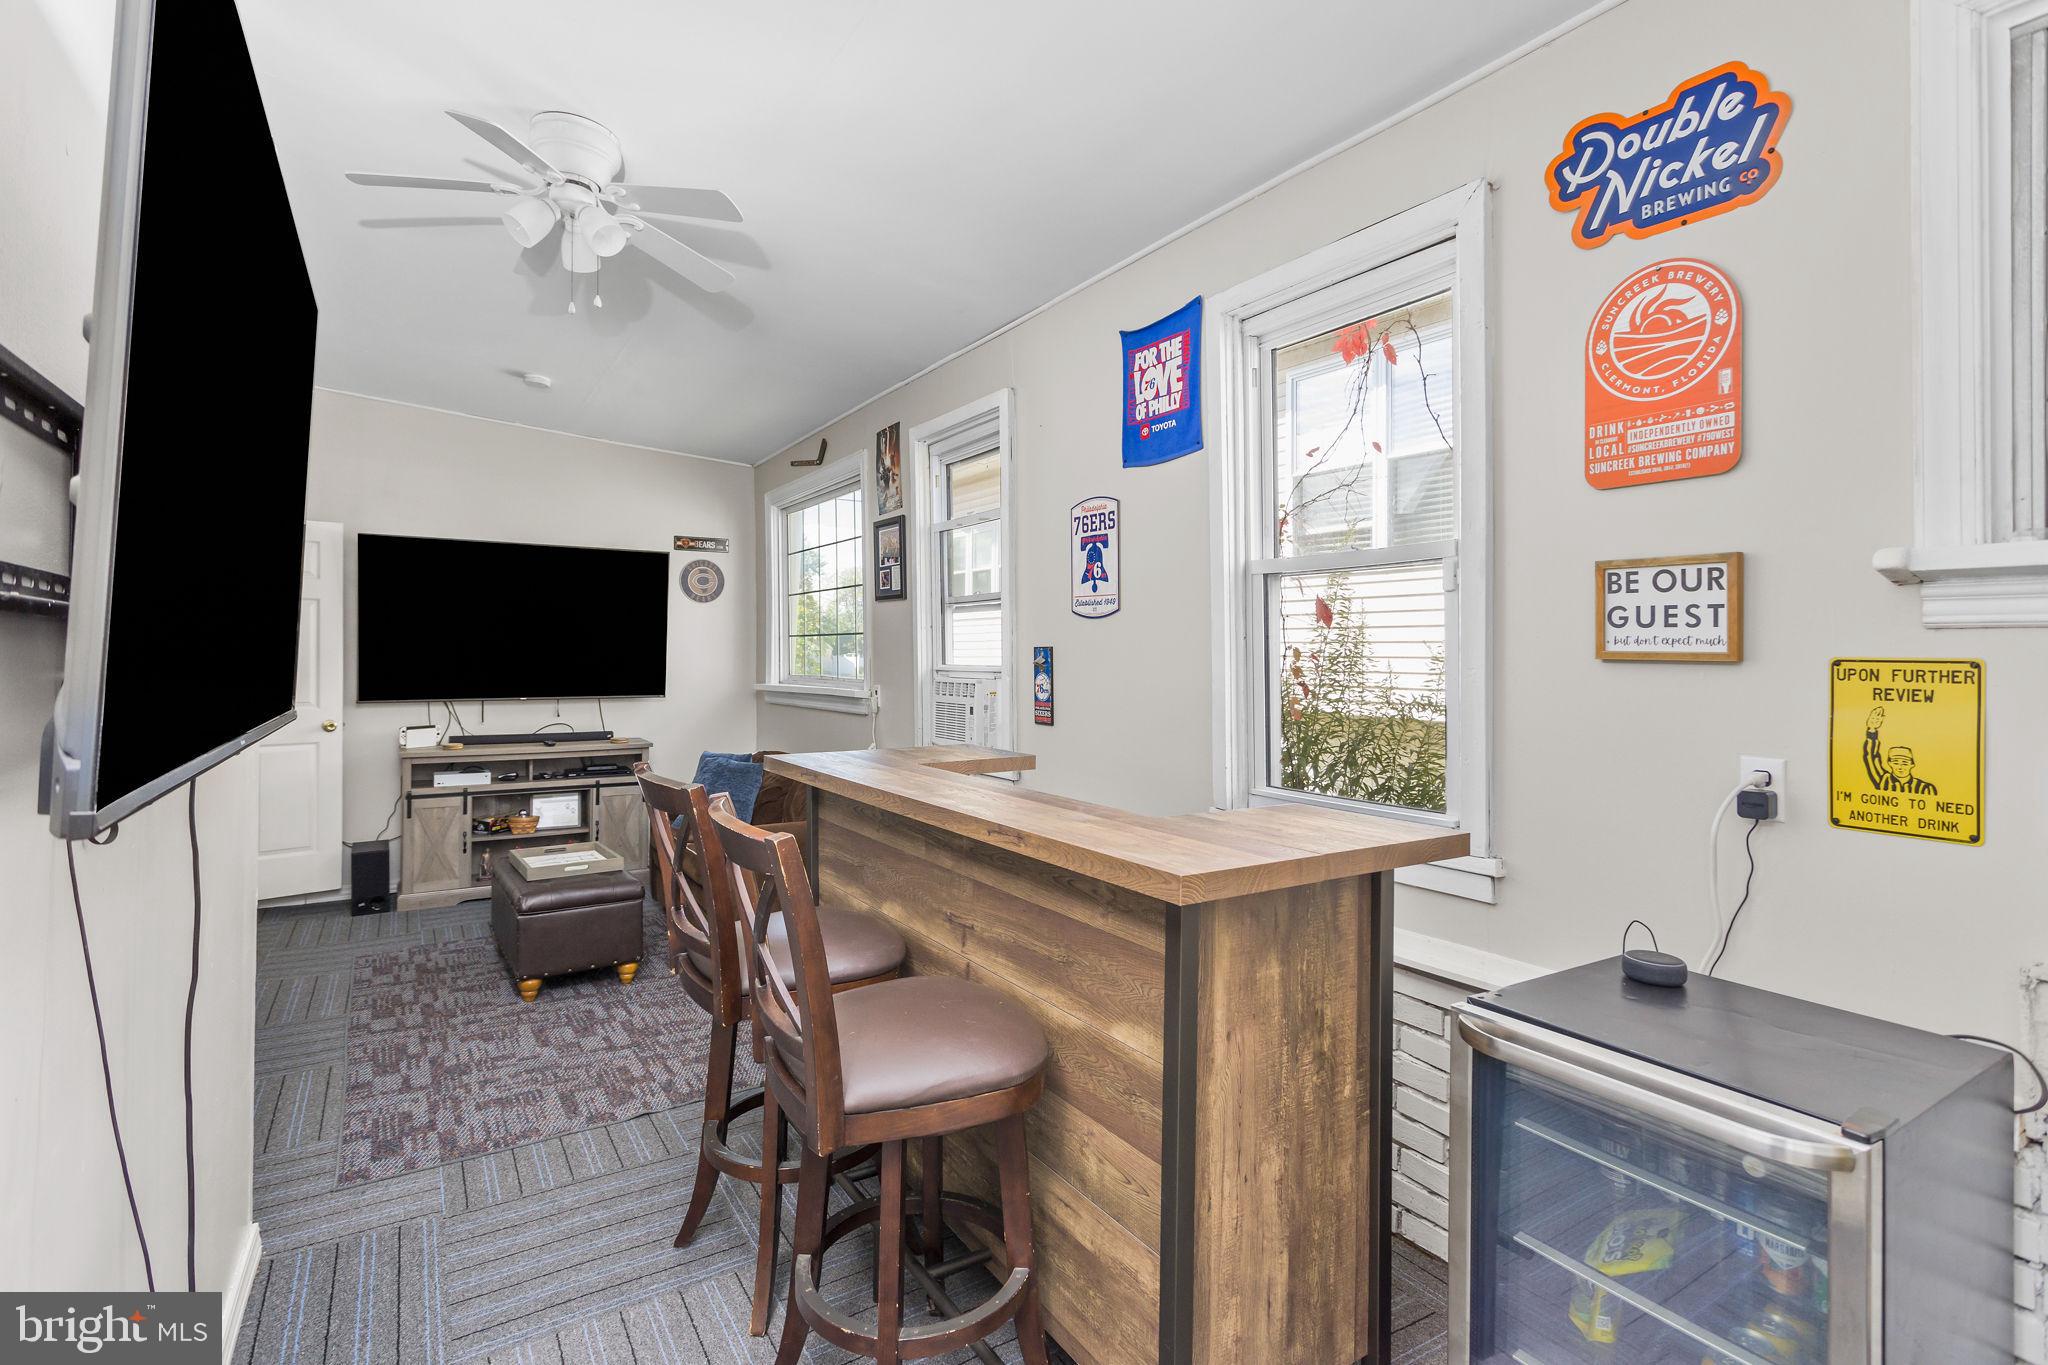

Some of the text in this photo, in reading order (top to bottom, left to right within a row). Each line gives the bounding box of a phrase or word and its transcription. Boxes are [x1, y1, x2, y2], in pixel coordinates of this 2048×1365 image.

[1563, 82, 1745, 194] Double
[1590, 113, 1768, 231] Nickel
[1641, 176, 1731, 220] BREWING
[1602, 270, 1724, 330] SUNCREEK BREWERY
[1133, 346, 1157, 372] FOR
[1159, 335, 1183, 364] THE
[1601, 336, 1722, 394] CLERMONT, FLORIDA
[1133, 355, 1183, 405] LOVE
[1135, 390, 1182, 421] OF PHILLY
[1151, 419, 1177, 433] TOYOTA
[1589, 421, 1625, 440] DRINK
[1629, 420, 1696, 442] INDEPENDENTLY
[1699, 414, 1730, 430] OWNED
[1589, 442, 1625, 460] LOCAL
[1589, 457, 1636, 475] SUNCREEK
[1638, 451, 1682, 468] BREWING
[1685, 441, 1735, 461] COMPANY
[1073, 510, 1116, 535] 76ERS
[694, 540, 716, 549] BEARS
[1607, 566, 1725, 594] BE OUR
[1607, 603, 1725, 629] GUEST
[1614, 635, 1631, 646] but
[1661, 635, 1693, 648] expect
[1695, 635, 1727, 647] much
[1836, 668, 1976, 685] UPON FURTHER
[1872, 688, 1935, 703] REVIEW
[1836, 790, 1975, 816] I'M GOING TO NEED
[1849, 810, 1960, 834] ANOTHER DRINK
